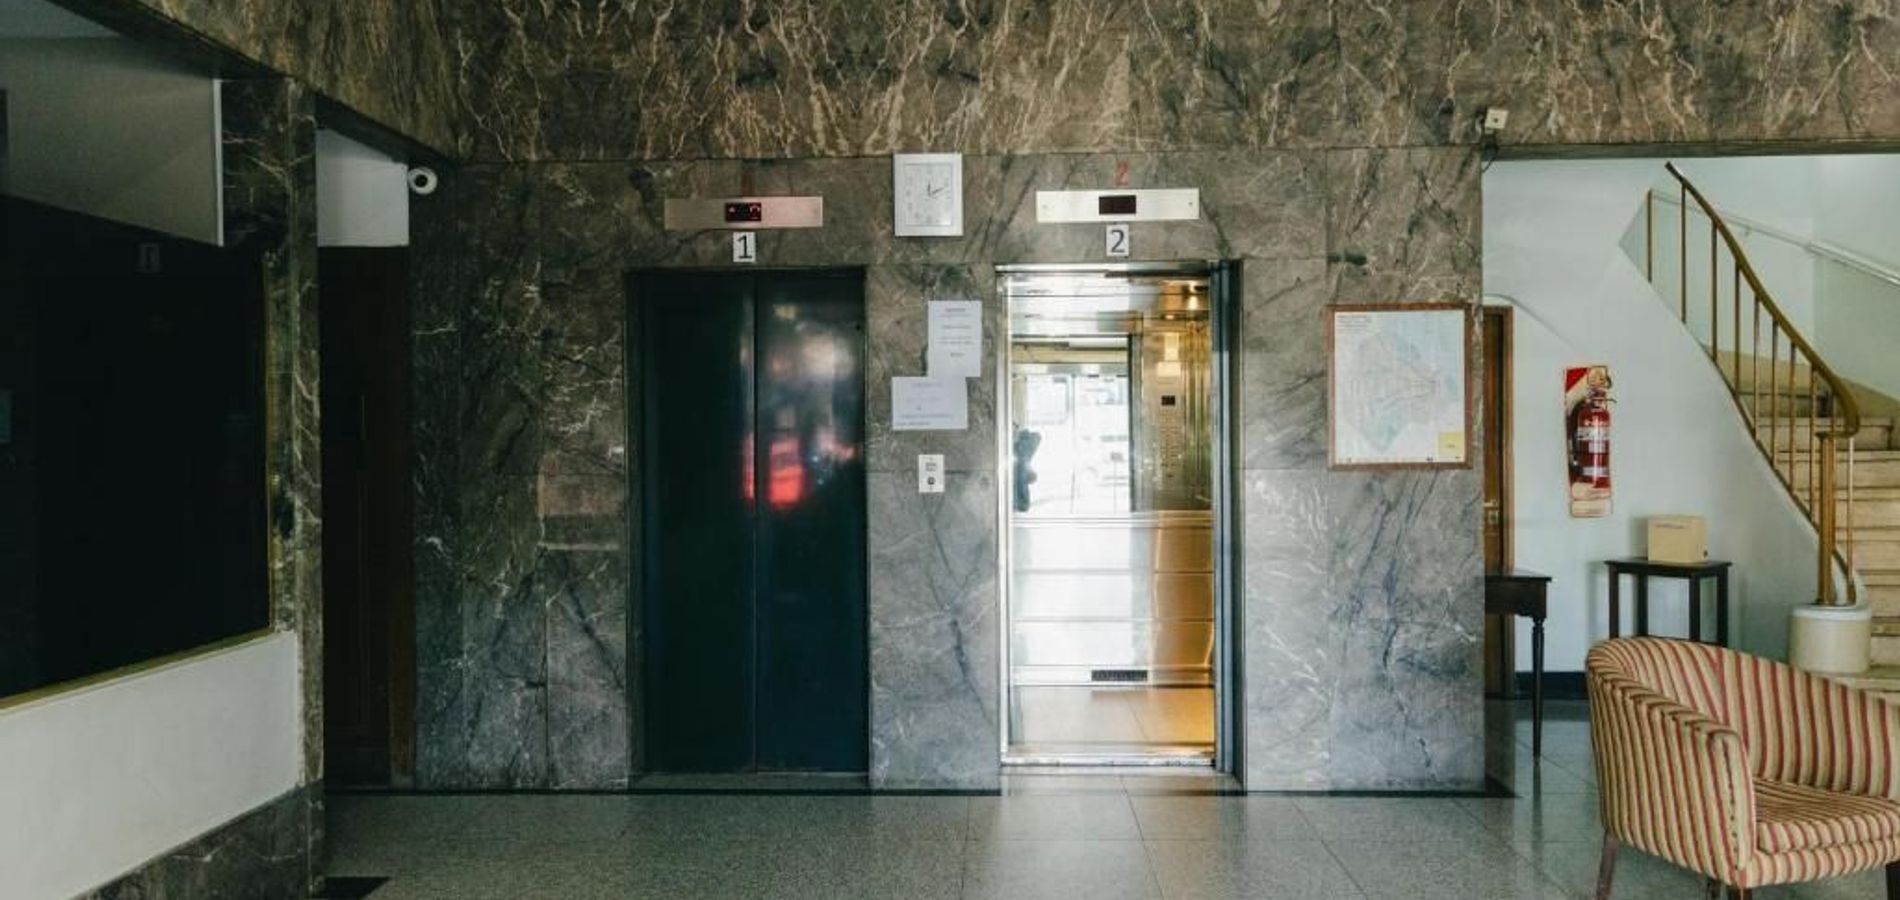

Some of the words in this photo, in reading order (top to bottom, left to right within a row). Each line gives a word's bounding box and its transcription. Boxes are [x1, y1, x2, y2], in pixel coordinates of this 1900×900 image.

[1115, 161, 1129, 187] 2
[736, 235, 753, 259] 1
[1111, 229, 1125, 253] 2
